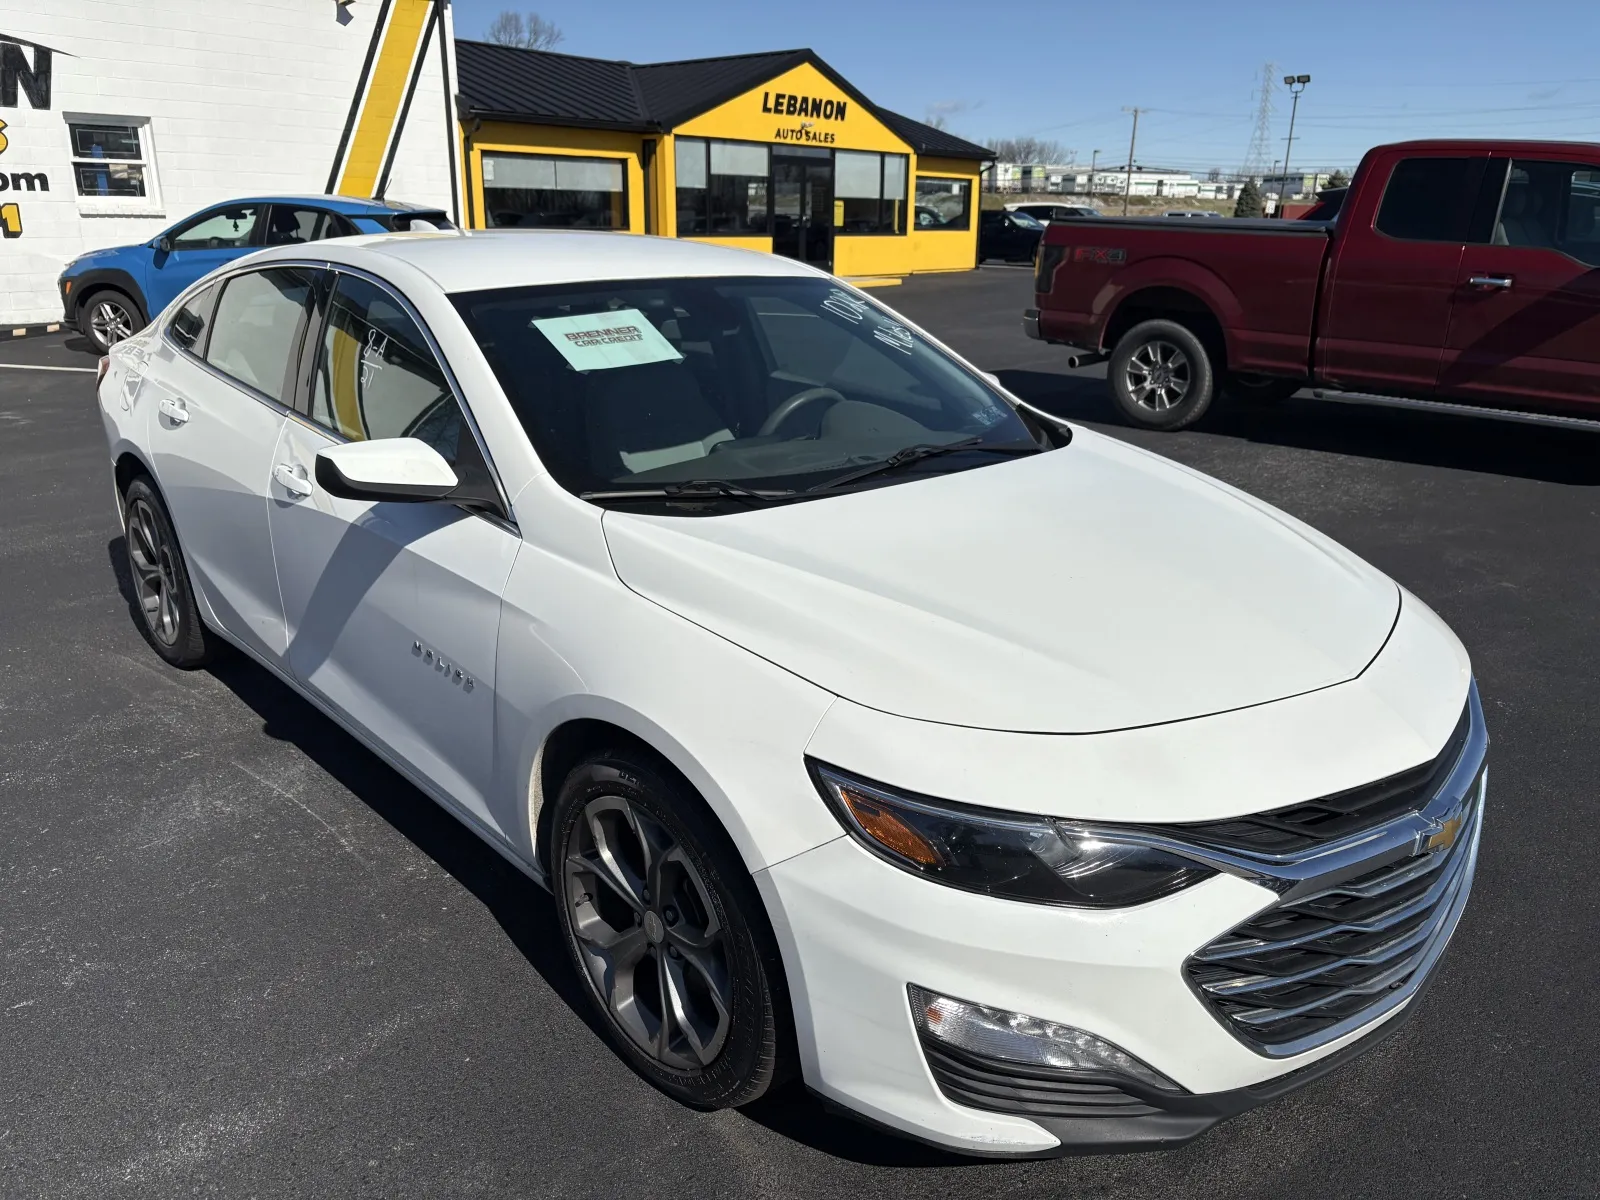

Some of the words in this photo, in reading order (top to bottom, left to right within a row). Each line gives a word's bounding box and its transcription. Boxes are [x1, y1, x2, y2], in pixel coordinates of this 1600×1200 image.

[762, 92, 847, 121] LEBANON
[774, 128, 802, 141] AUTO
[804, 130, 835, 144] SALES
[1074, 247, 1127, 264] FX4
[564, 325, 643, 341] BRENNER
[574, 339, 603, 347] CAR
[600, 334, 644, 344] CREDIT
[413, 640, 475, 689] MALIBU
